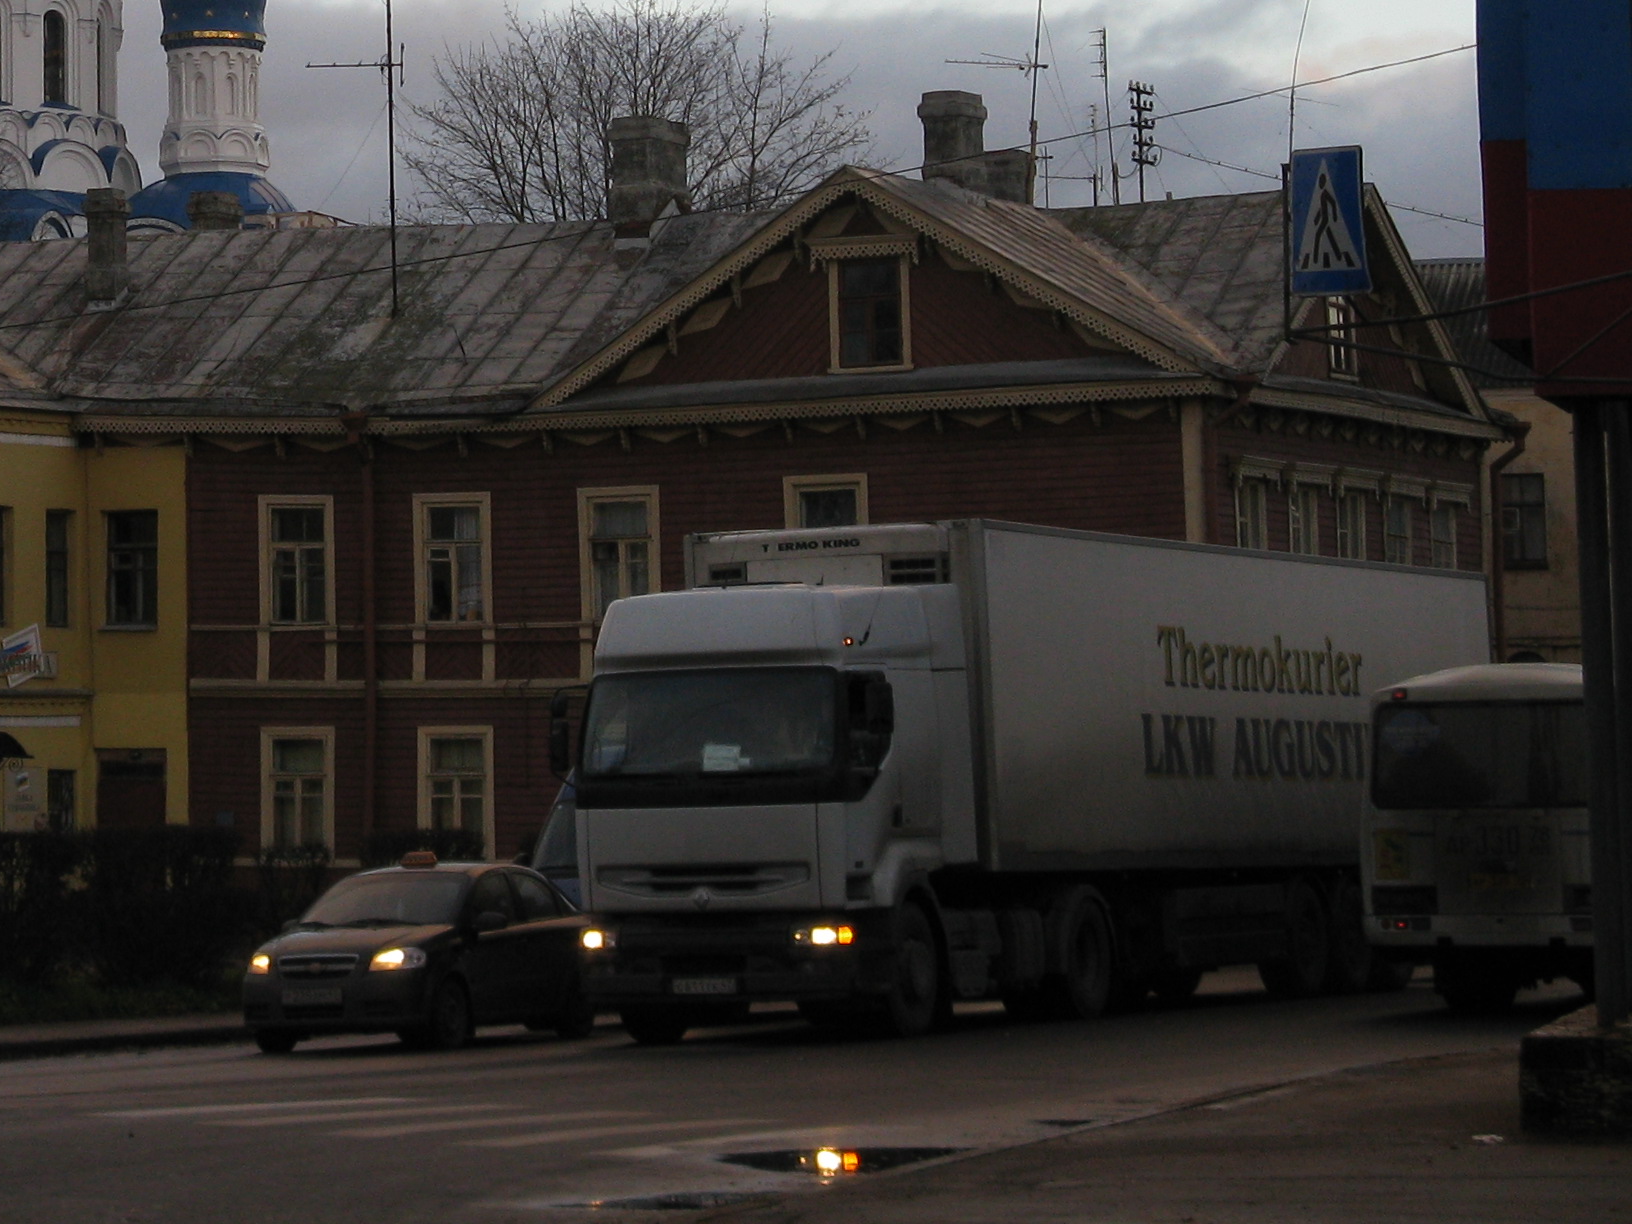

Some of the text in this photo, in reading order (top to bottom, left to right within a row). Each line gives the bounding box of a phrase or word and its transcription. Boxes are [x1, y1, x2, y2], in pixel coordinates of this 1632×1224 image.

[822, 538, 860, 549] KING
[1157, 626, 1362, 696] Thermokurier
[1141, 714, 1215, 778] LKW
[1233, 719, 1369, 781] AUGUSTI
